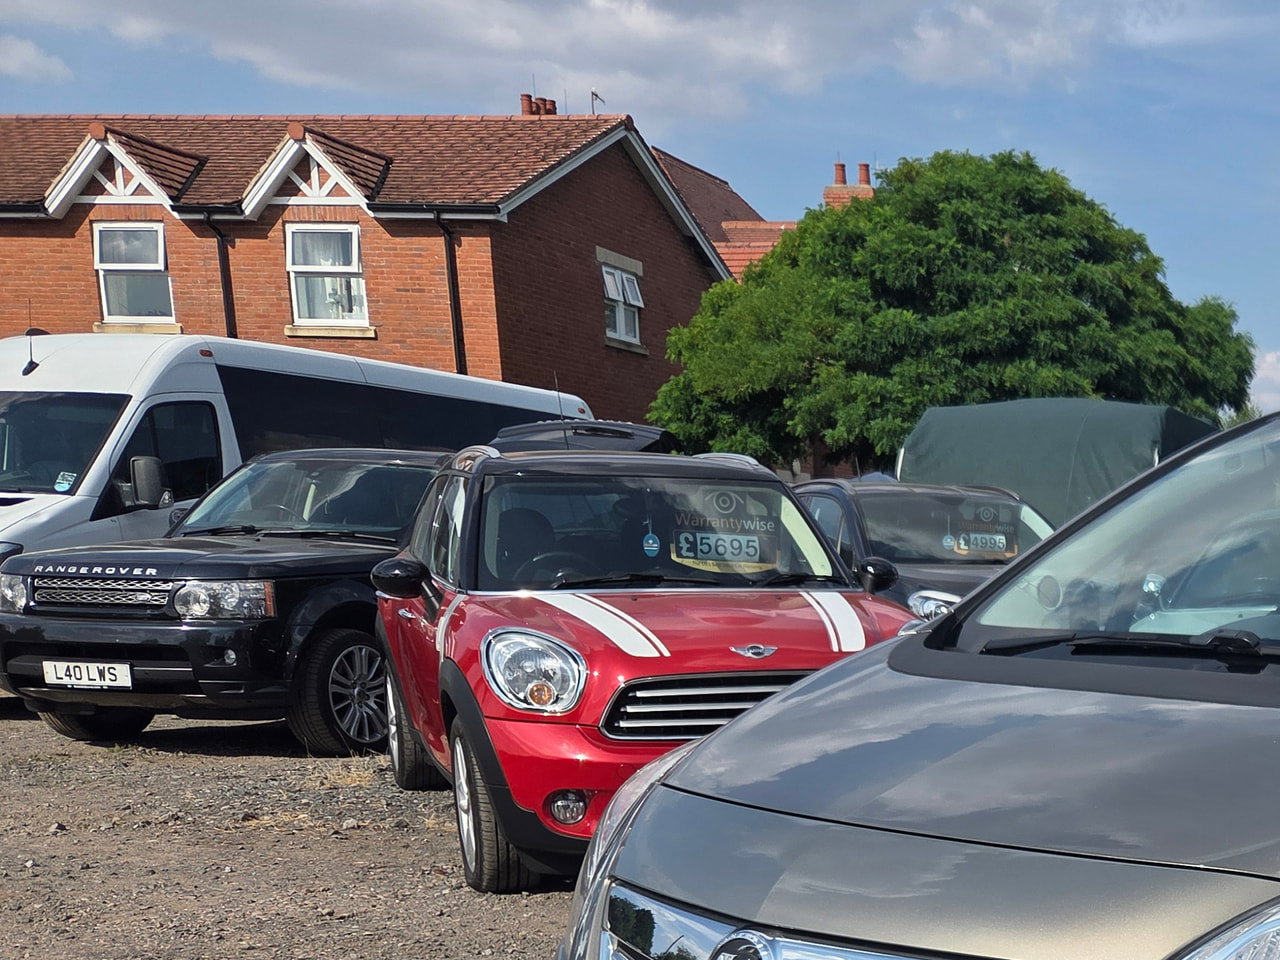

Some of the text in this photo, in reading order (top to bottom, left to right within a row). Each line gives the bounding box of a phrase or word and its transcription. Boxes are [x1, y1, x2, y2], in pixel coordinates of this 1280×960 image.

[675, 512, 776, 532] Warrantywise
[679, 532, 759, 557] £5695
[959, 533, 1005, 550] £4995
[34, 565, 157, 576] RANGE ROVER
[53, 663, 118, 682] L40 LWS
